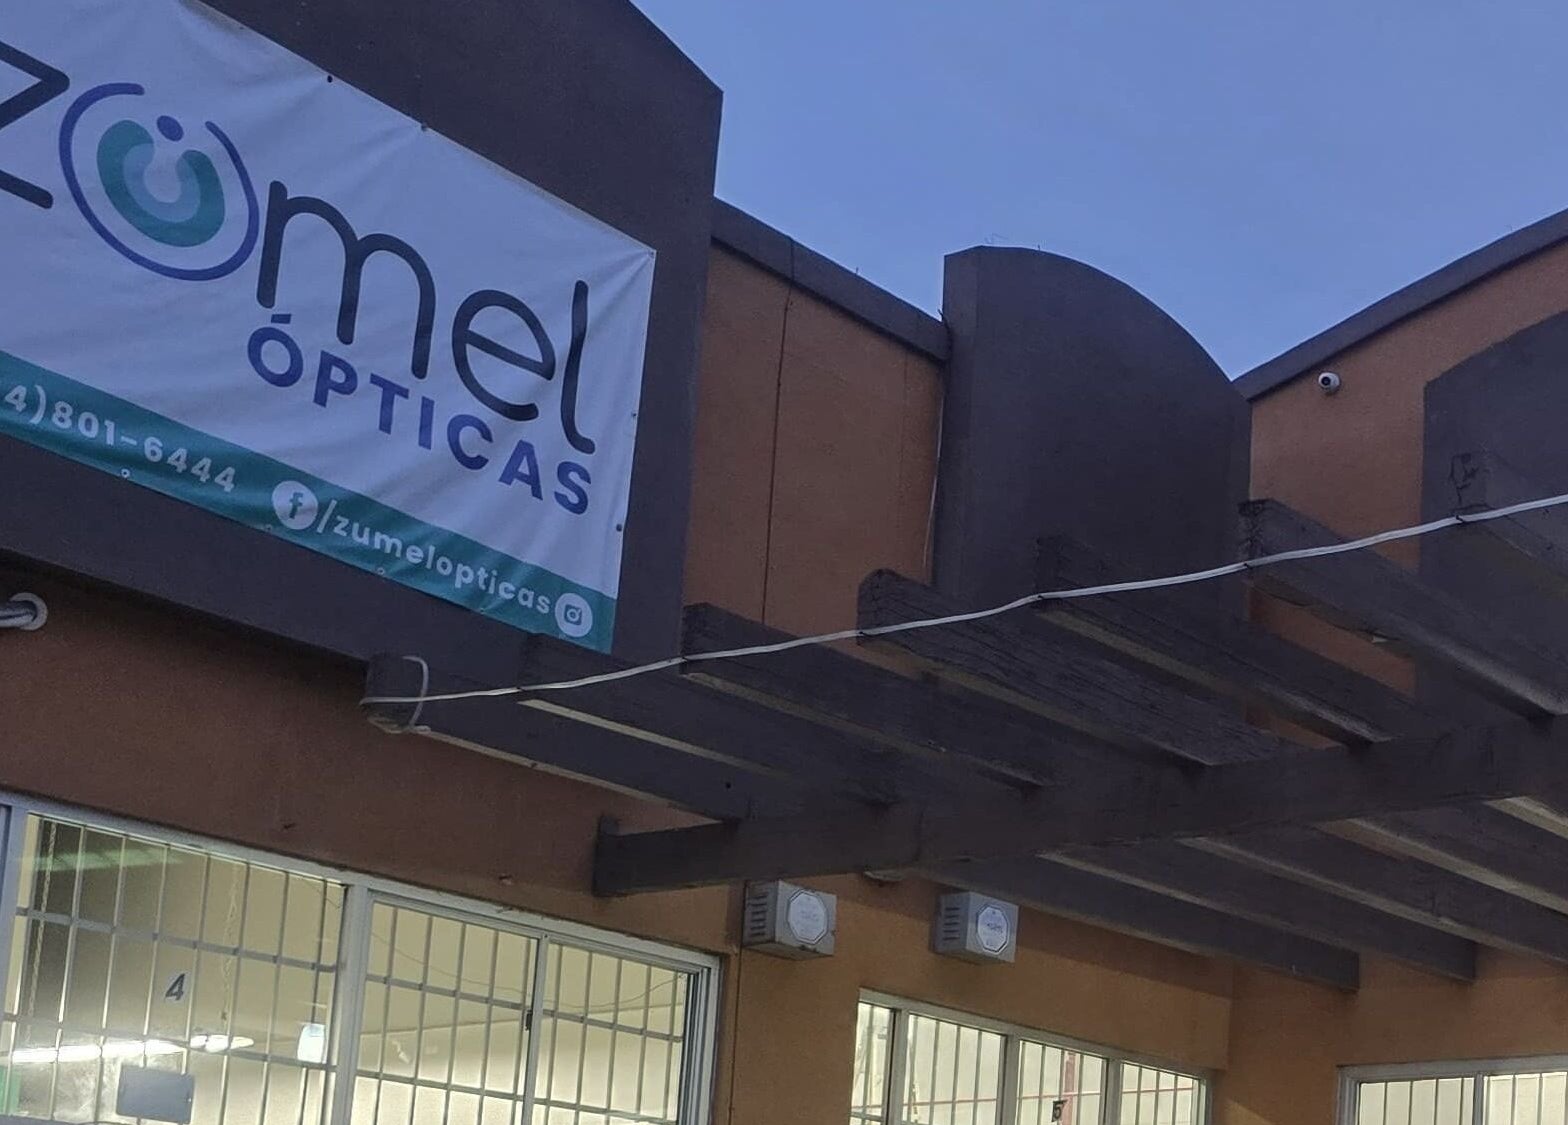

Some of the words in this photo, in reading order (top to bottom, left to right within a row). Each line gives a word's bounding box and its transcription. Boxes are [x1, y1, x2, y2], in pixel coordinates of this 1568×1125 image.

[246, 312, 590, 516] ÓPTICAS
[165, 972, 186, 1001] 4
[1052, 1100, 1066, 1121] 5
